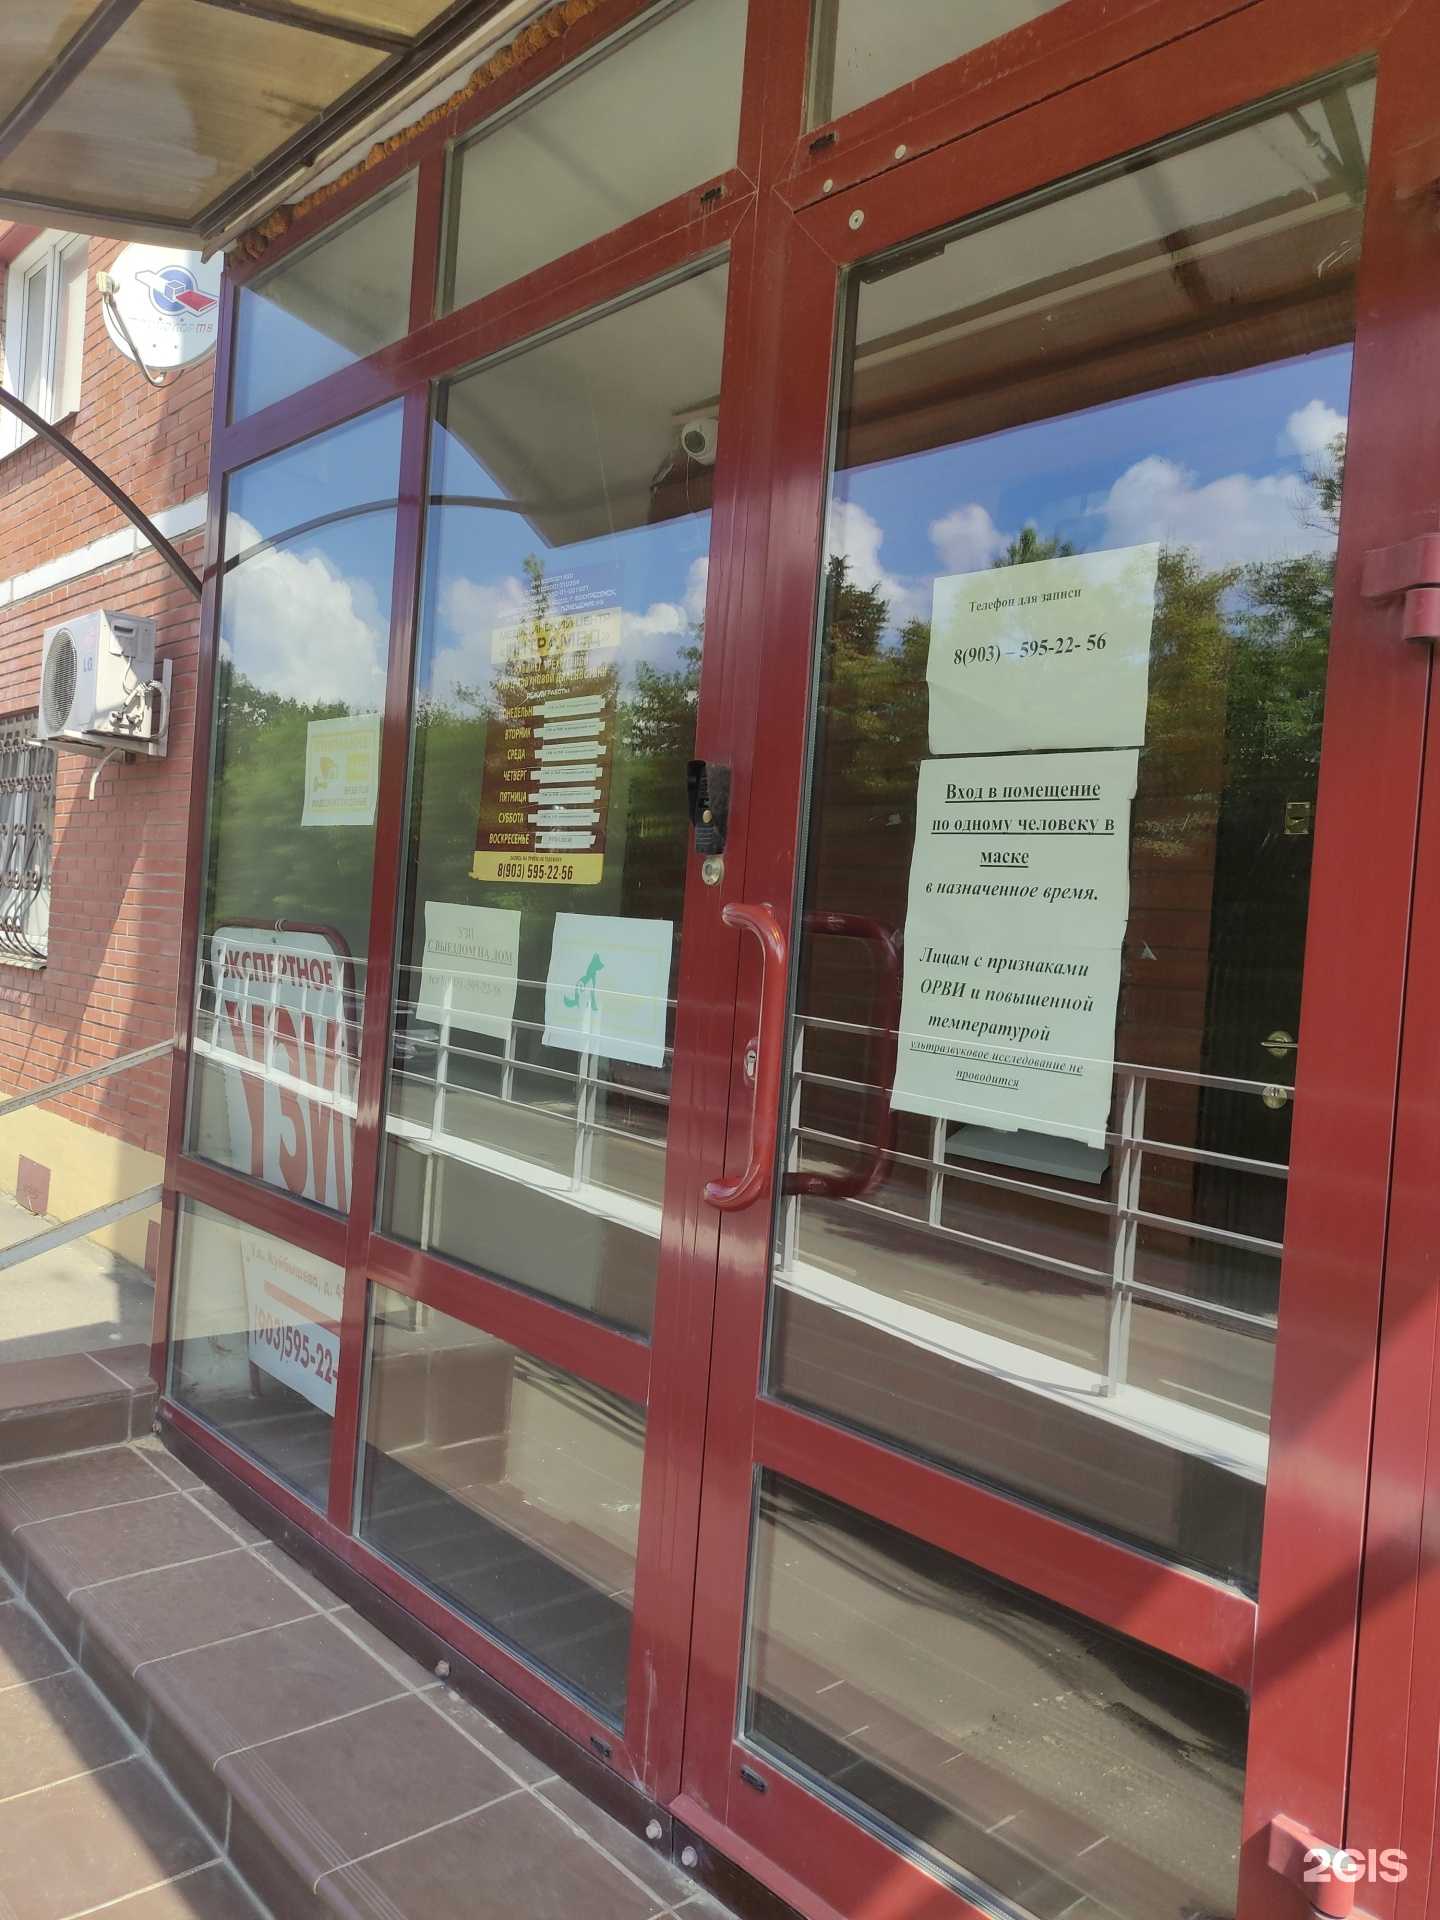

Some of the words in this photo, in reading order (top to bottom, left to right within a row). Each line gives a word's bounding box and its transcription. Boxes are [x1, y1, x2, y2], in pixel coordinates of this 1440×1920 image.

[969, 594, 1015, 613] Телефон
[1018, 593, 1038, 608] для
[1041, 588, 1082, 603] записи
[83, 656, 93, 672] LG
[953, 645, 1001, 666] 8(903)
[504, 729, 531, 741] ВТОРНИК
[507, 749, 526, 761] СРЕДА
[503, 770, 527, 782] ЧЕТВЕРГ
[499, 792, 528, 804] ПЯТНИЦА
[946, 783, 983, 801] Вход
[988, 787, 997, 799] в
[1003, 783, 1101, 801] помещение
[498, 813, 524, 824] СУББОТА
[931, 818, 949, 832] по
[954, 817, 1013, 834] одному
[1018, 816, 1099, 834] человеку
[1104, 819, 1115, 832] в
[489, 833, 530, 845] ВОСКРЕСЕНЬЕ
[980, 850, 1029, 865] маске
[497, 863, 525, 879] 8(903)
[527, 864, 573, 881] 595-22-56
[926, 881, 933, 894] в
[937, 881, 1039, 899] назначенное
[1043, 886, 1099, 903] время.
[919, 947, 969, 968] Лицам
[974, 956, 984, 968] с
[987, 956, 1089, 977] признаками
[920, 978, 966, 999] ОРВИ
[970, 987, 980, 1000] и
[985, 989, 1095, 1012] повышенной
[928, 1013, 1051, 1042] температурой
[992, 1051, 1066, 1072] исследование
[1068, 1062, 1084, 1075] не
[955, 1068, 1020, 1089] проводится
